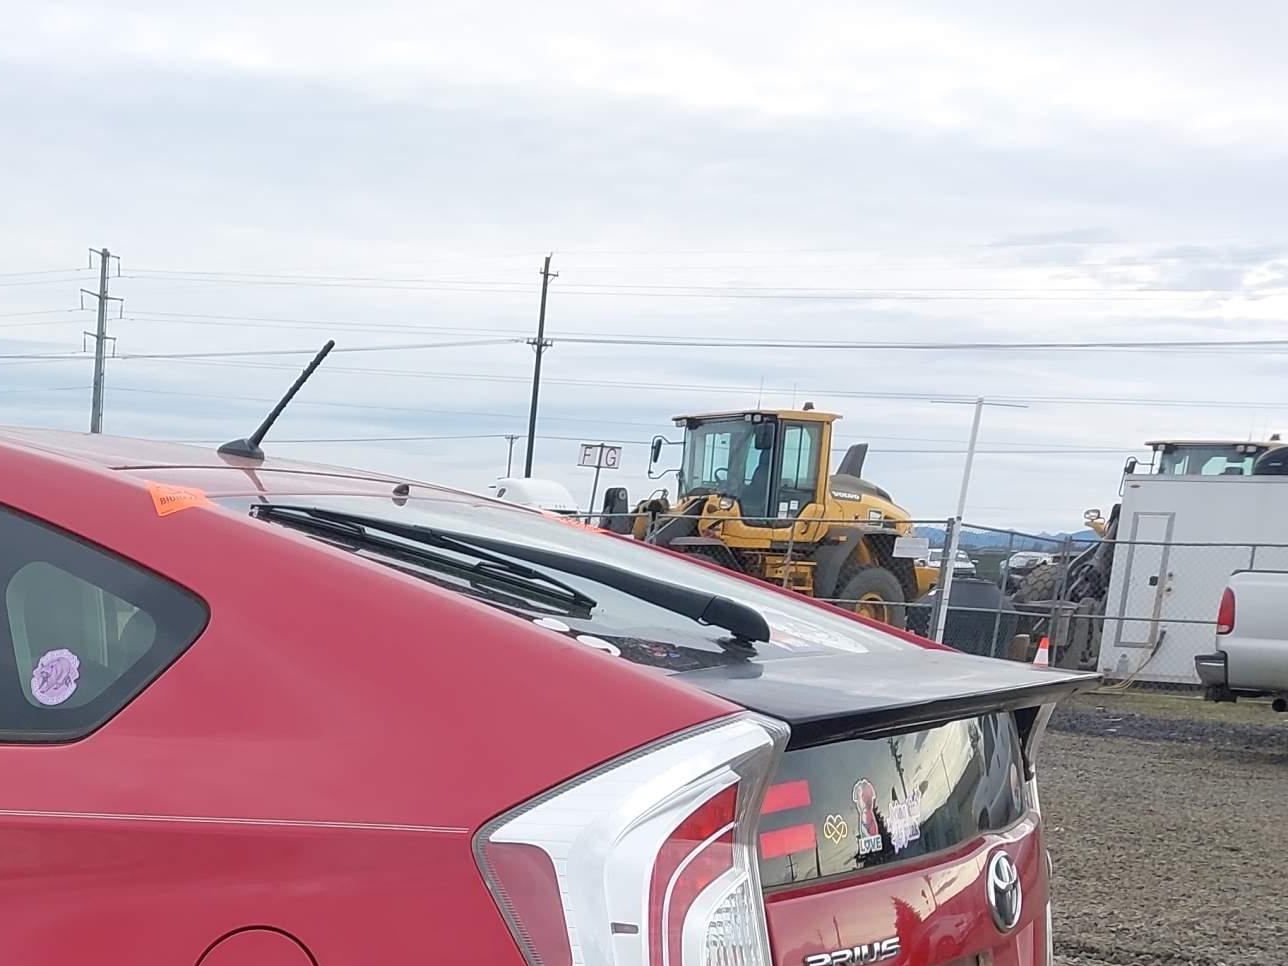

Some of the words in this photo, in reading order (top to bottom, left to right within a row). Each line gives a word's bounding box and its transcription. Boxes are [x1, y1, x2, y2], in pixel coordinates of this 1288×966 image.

[583, 446, 593, 464] F
[605, 448, 617, 467] G
[860, 837, 882, 853] LOVE
